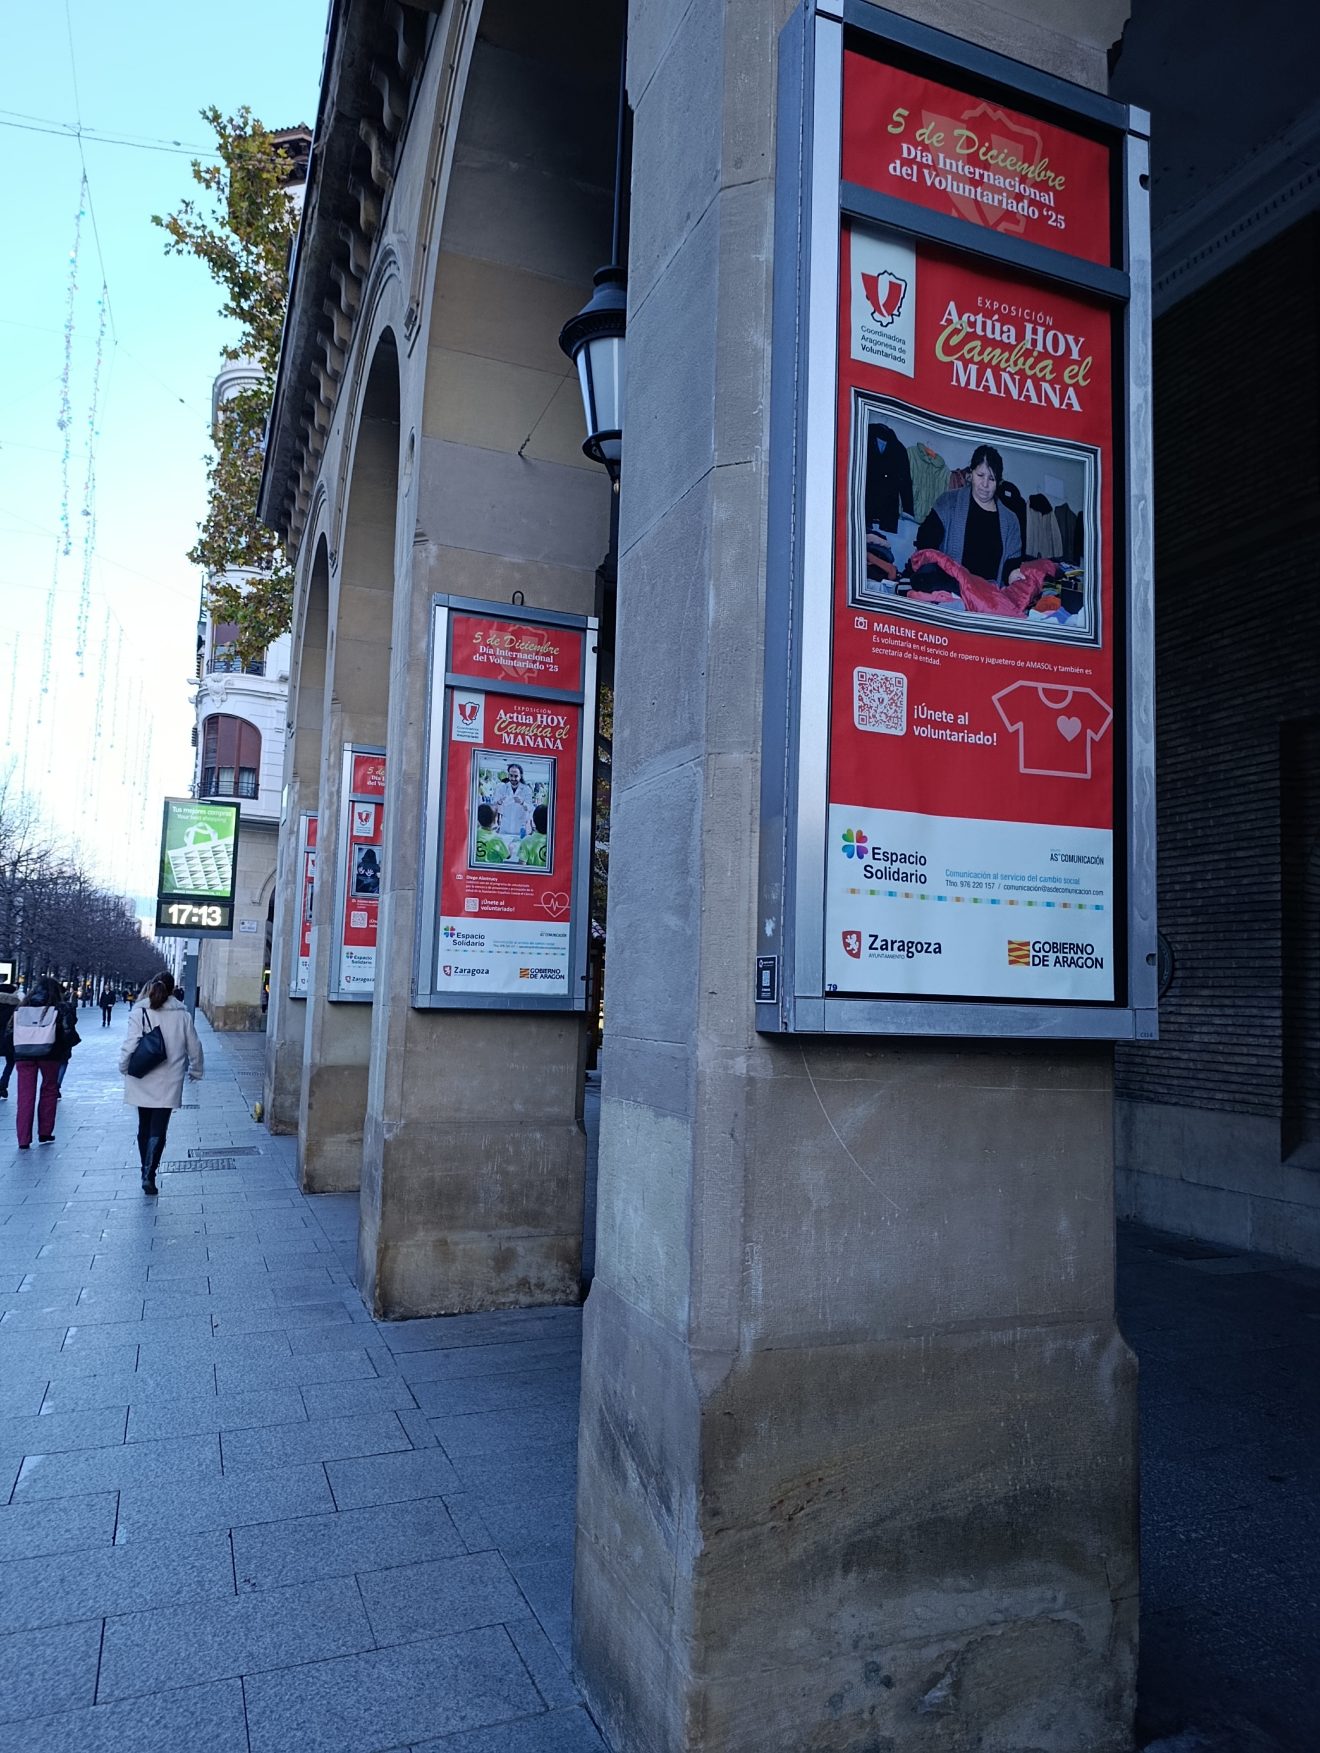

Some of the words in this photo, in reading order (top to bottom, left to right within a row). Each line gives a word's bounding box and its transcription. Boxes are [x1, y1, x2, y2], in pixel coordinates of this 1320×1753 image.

[887, 107, 909, 134] 5
[915, 121, 945, 147] de
[953, 129, 1066, 190] Diciembre
[901, 143, 933, 166] Día
[937, 152, 1055, 207] Internacional
[888, 159, 917, 183] del
[922, 168, 1039, 219] Voluntariado
[977, 296, 1053, 326] EXPOSICIÓN
[861, 325, 906, 345] Coordinadora
[939, 300, 1017, 345] Actúa
[1024, 322, 1085, 361] HOY
[861, 334, 897, 351] Aragonesa
[898, 346, 906, 355] de
[861, 343, 906, 364] Voluntariado
[935, 320, 1057, 381] Cambia
[1063, 355, 1093, 387] el
[950, 360, 1083, 412] MAÑANA
[472, 631, 484, 643] 5
[486, 634, 500, 646] de
[503, 635, 560, 655] Diciembre
[873, 622, 916, 639] MARLENE
[918, 632, 949, 646] CANDO
[472, 653, 487, 662] del
[489, 655, 545, 670] Voluntariado
[479, 645, 494, 654] Día
[496, 647, 553, 663] Internacional
[872, 634, 880, 643] Es
[880, 636, 912, 648] voluntaria
[920, 644, 926, 652] el
[926, 647, 949, 657] servicio
[949, 650, 957, 658] de
[958, 653, 979, 662] ropero
[985, 655, 1016, 666] juguetero
[1016, 659, 1025, 667] de
[1025, 660, 1053, 671] AMASOL
[1058, 664, 1084, 674] también
[903, 651, 912, 659] de
[912, 652, 919, 660] la
[919, 655, 941, 666] entidad.
[496, 709, 533, 724] Actúa
[536, 713, 567, 727] HOY
[513, 705, 552, 714] EXPOSICIÓN
[913, 703, 954, 724] ¡Únete
[957, 711, 969, 725] al
[493, 718, 552, 737] Cambia
[555, 724, 570, 739] el
[913, 724, 998, 746] voluntariado!
[871, 846, 927, 867] Espacio
[863, 864, 927, 884] Solidario
[945, 869, 991, 879] Comunicación
[1000, 873, 1025, 882] servicio
[1027, 874, 1037, 882] del
[1039, 875, 1062, 884] cambio
[1063, 877, 1080, 885] social
[960, 880, 971, 888] 976
[971, 881, 983, 889] 220
[984, 882, 995, 890] 157
[168, 904, 221, 926] 17:13
[452, 939, 485, 947] Solidario
[456, 932, 485, 940] Espacio
[868, 934, 942, 959] Zaragoza
[1032, 941, 1094, 955] GOBIERNO
[453, 966, 490, 977] Zaragoza
[1032, 955, 1050, 967] DE
[827, 983, 838, 991] 79
